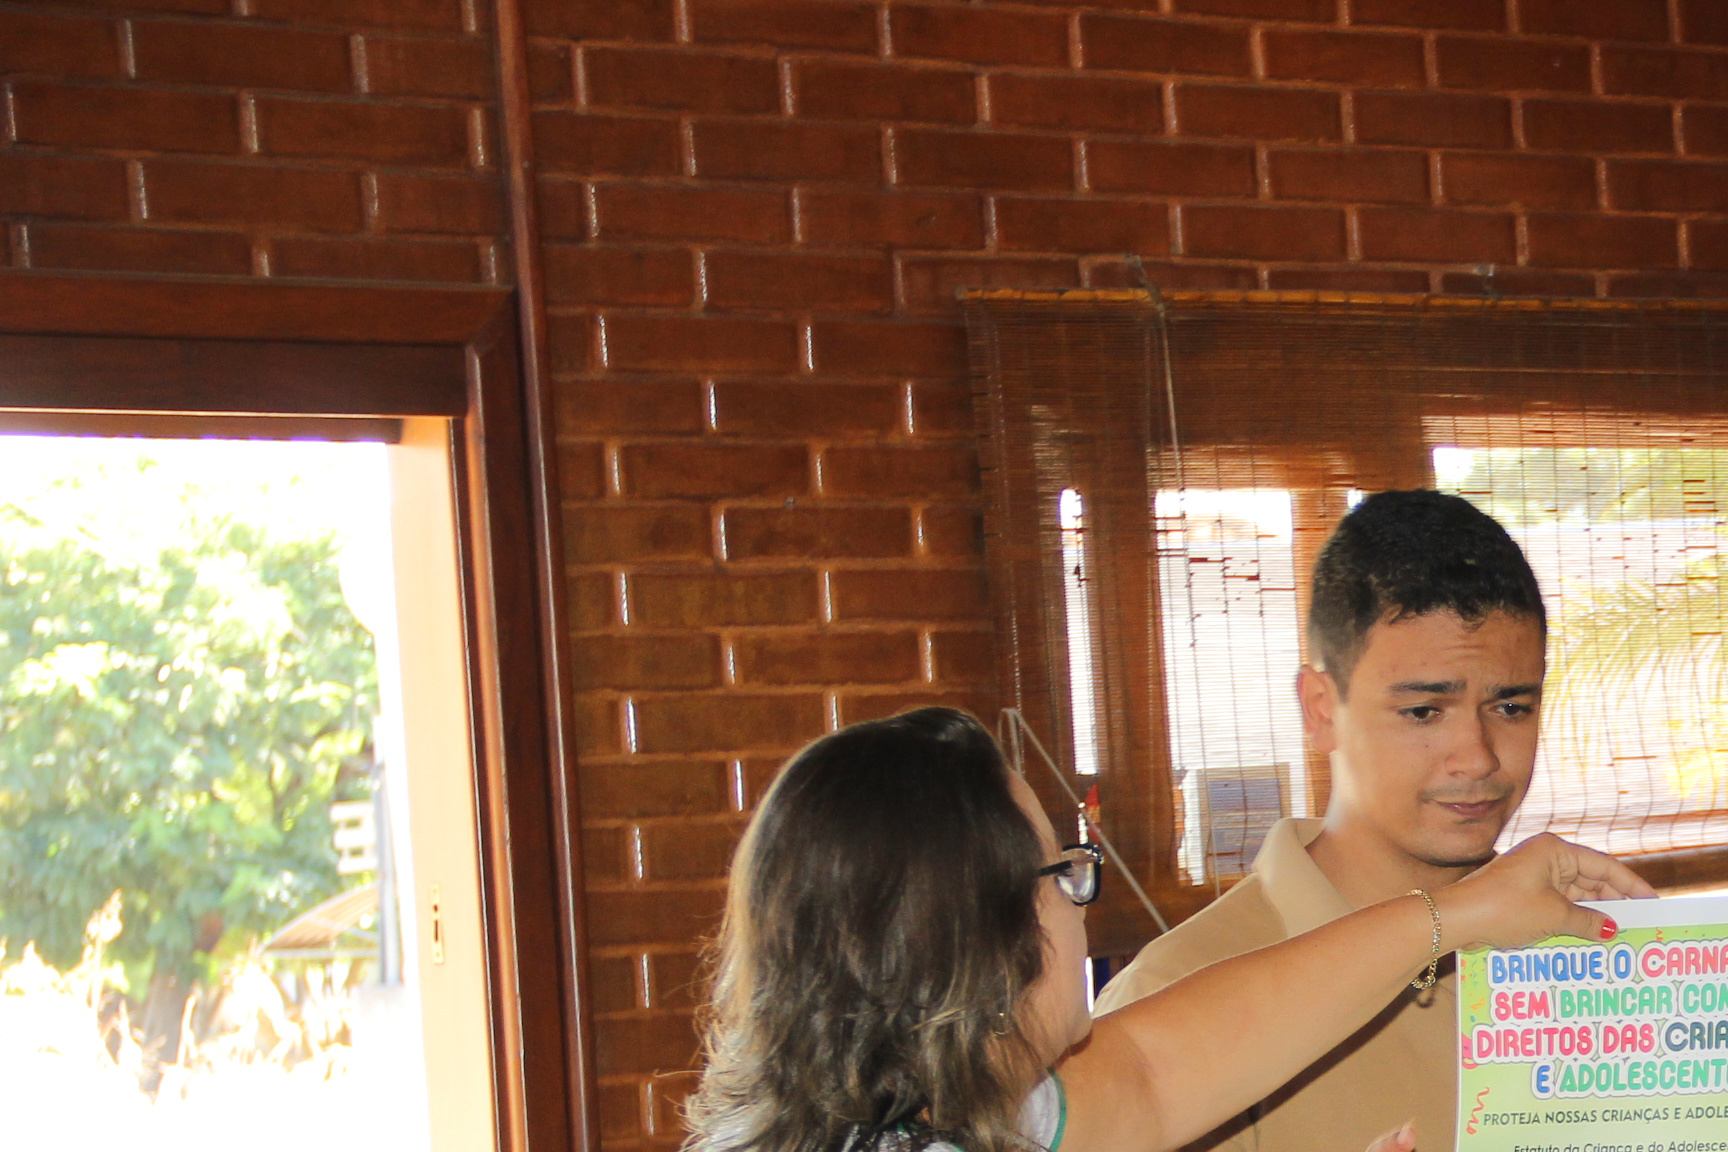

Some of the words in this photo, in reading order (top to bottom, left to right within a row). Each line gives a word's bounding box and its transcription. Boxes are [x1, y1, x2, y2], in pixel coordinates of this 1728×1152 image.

[1492, 951, 1604, 983] BRINQUE
[1613, 950, 1631, 979] O
[1495, 990, 1551, 1020] SEM
[1560, 985, 1672, 1018] BRINCAR
[1476, 1026, 1593, 1058] DIREITOS
[1603, 1024, 1655, 1054] DAS
[1536, 1064, 1550, 1093] E
[1483, 1112, 1541, 1125] PROTEJA
[1545, 1110, 1598, 1124] NOSSAS
[1602, 1107, 1669, 1124] CRIANÇAS
[1674, 1107, 1681, 1119] E
